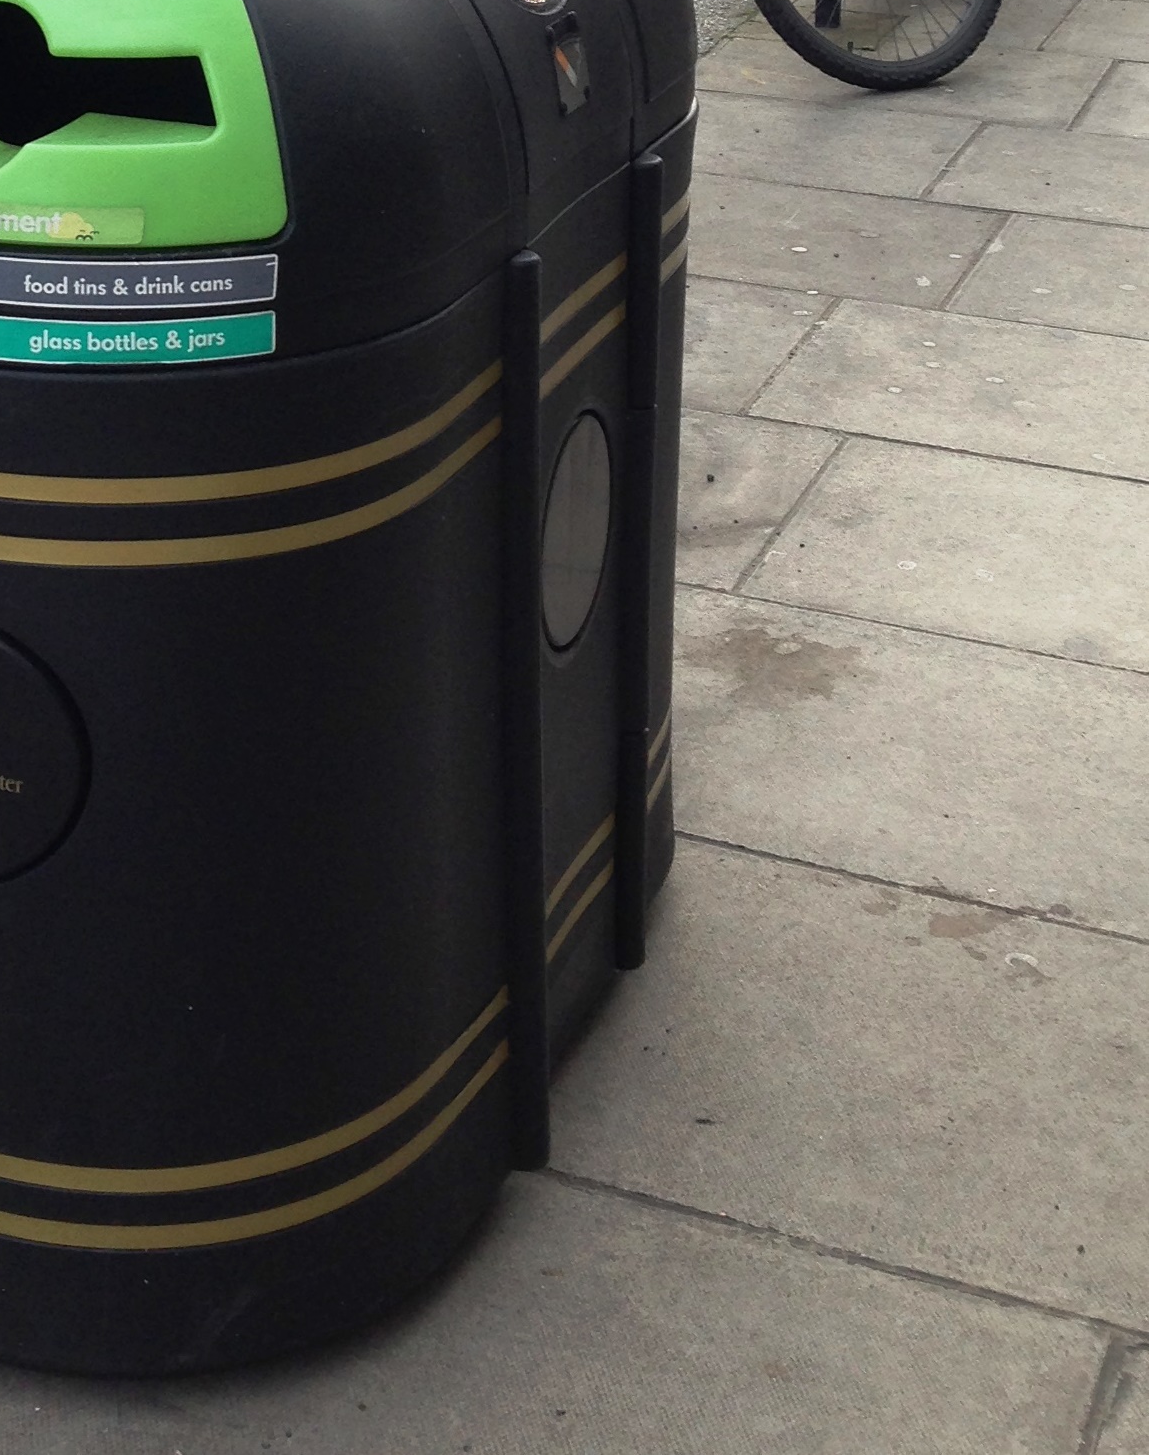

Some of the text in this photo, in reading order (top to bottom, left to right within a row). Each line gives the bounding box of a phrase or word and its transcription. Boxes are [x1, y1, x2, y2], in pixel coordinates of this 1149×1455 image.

[24, 274, 233, 295] food tins & drink cans
[29, 329, 225, 353] glass bottles & jars
